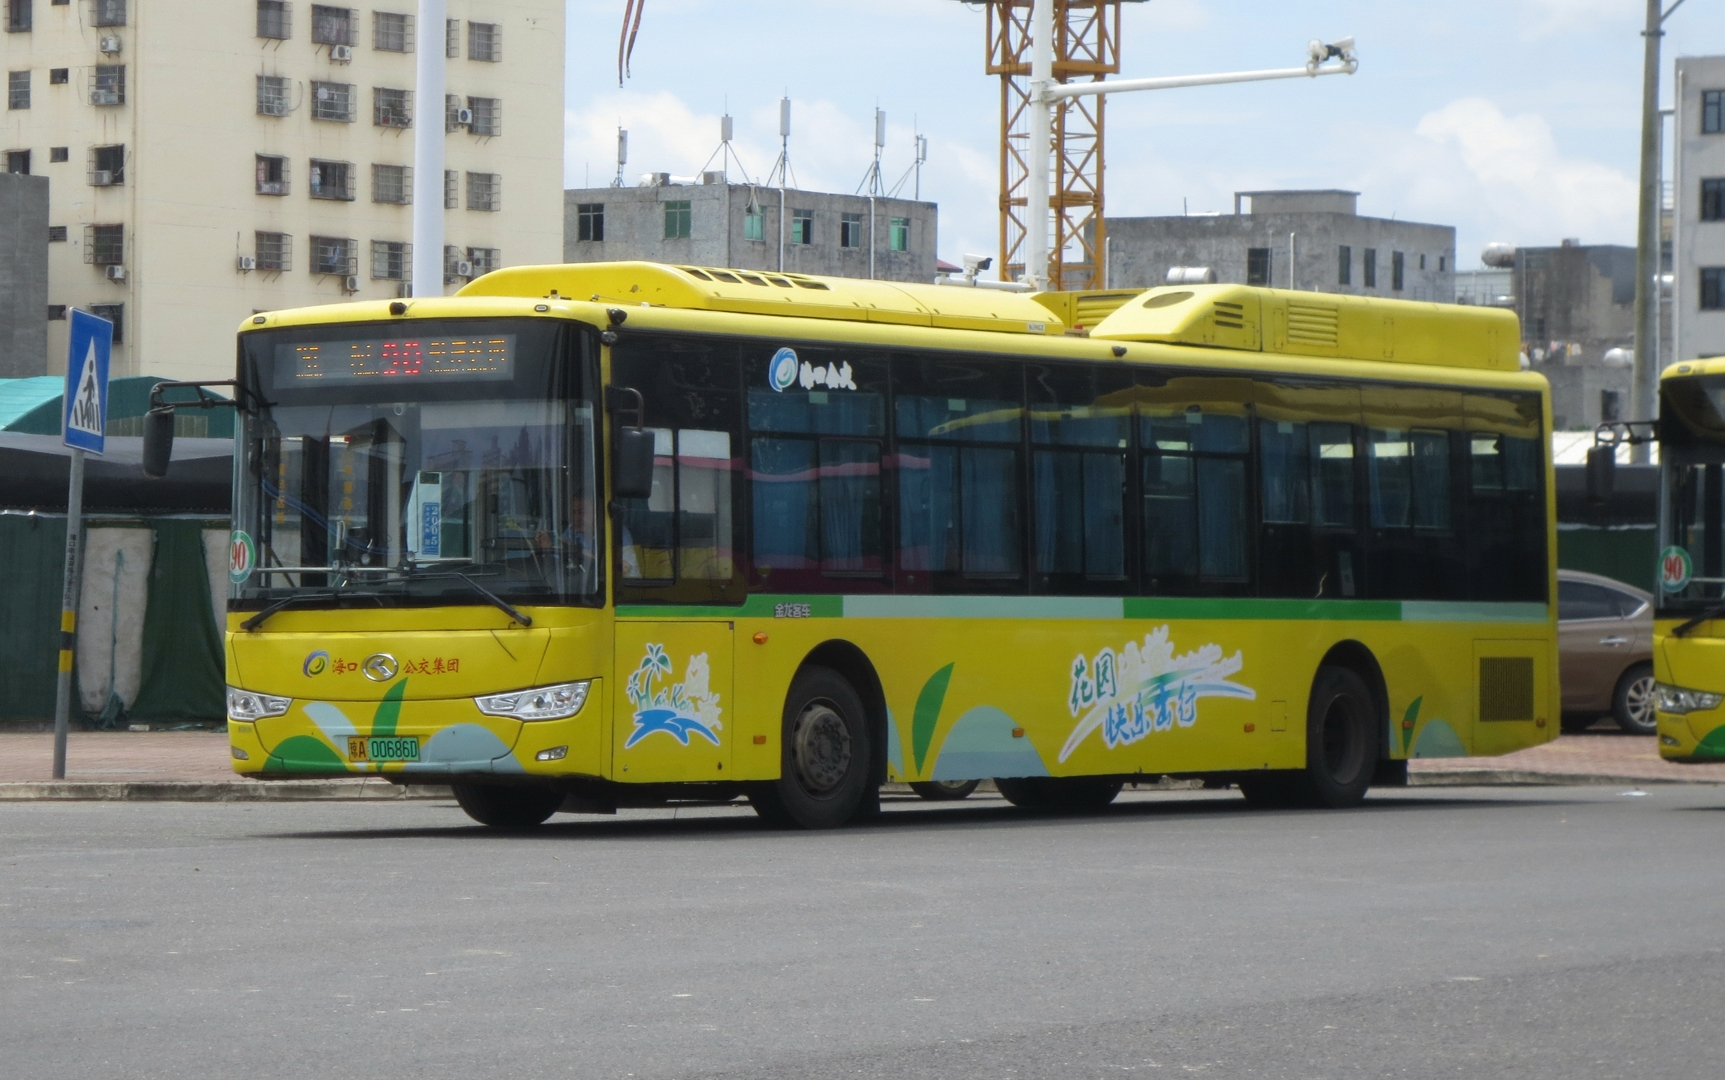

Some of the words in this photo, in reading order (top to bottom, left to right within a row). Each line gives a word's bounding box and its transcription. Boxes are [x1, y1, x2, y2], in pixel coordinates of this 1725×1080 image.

[231, 541, 246, 571] 90
[1664, 555, 1683, 581] 90
[774, 603, 811, 618] 金龙客车
[332, 659, 358, 675] 海口
[403, 657, 459, 675] 公交集团
[371, 740, 418, 758] 00686D
